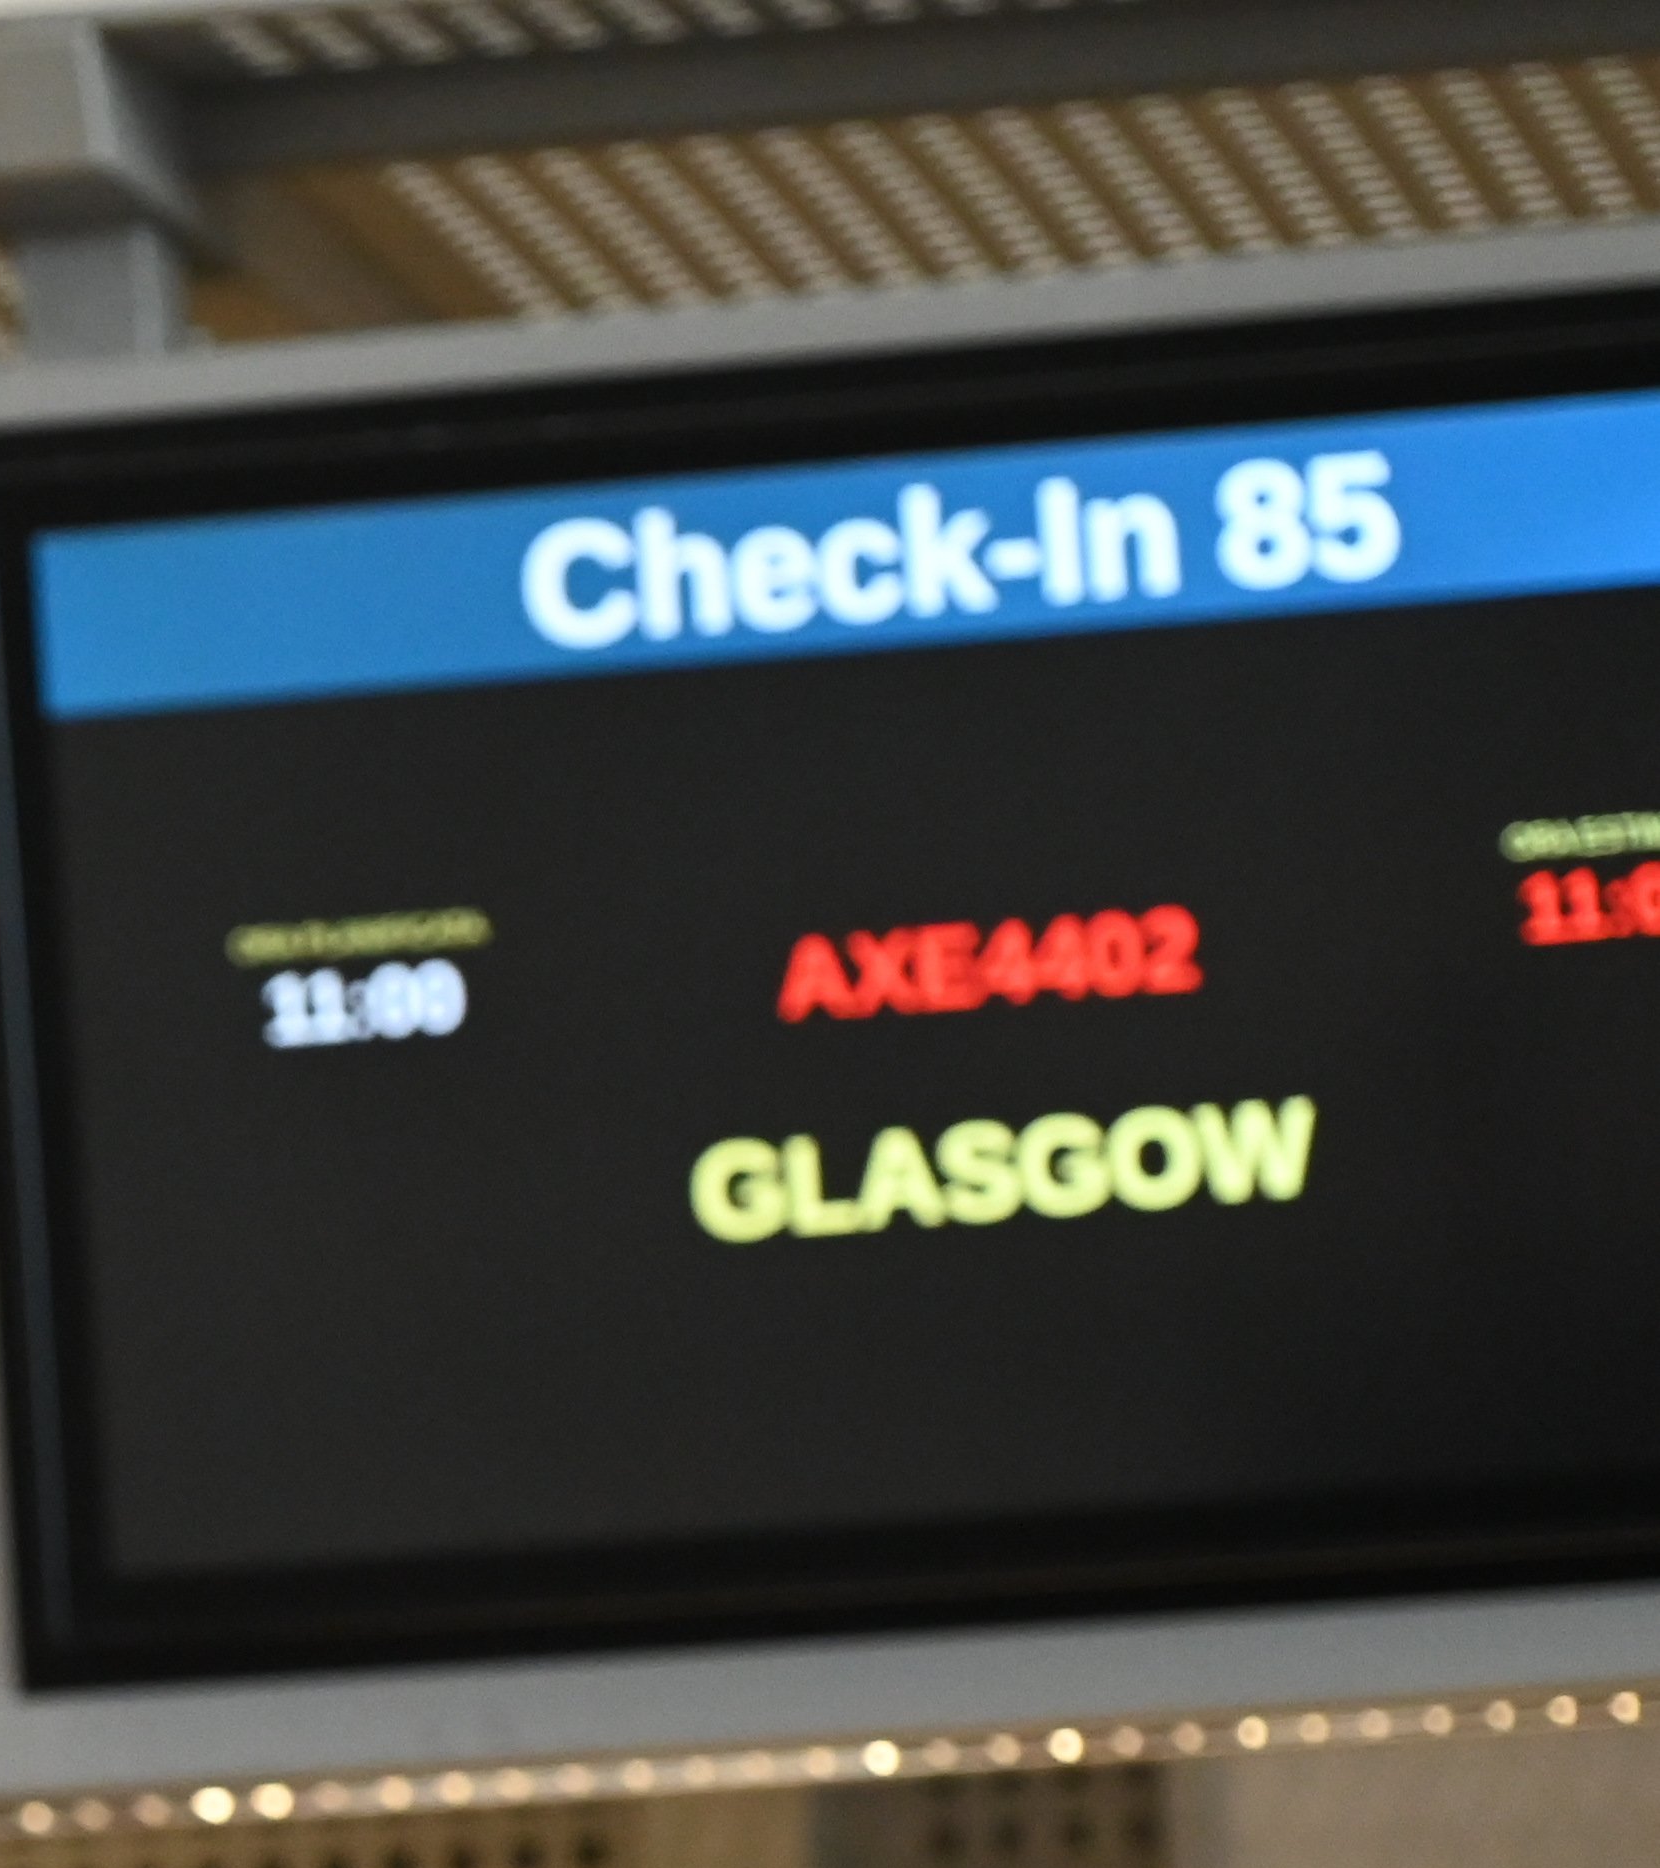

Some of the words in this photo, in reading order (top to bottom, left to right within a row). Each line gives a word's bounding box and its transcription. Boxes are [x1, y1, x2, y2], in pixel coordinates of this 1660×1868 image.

[521, 474, 1183, 650] Check-In
[1215, 448, 1403, 592] 85
[778, 903, 1204, 1022] AXE4402
[689, 1095, 1317, 1244] GLASGOW
